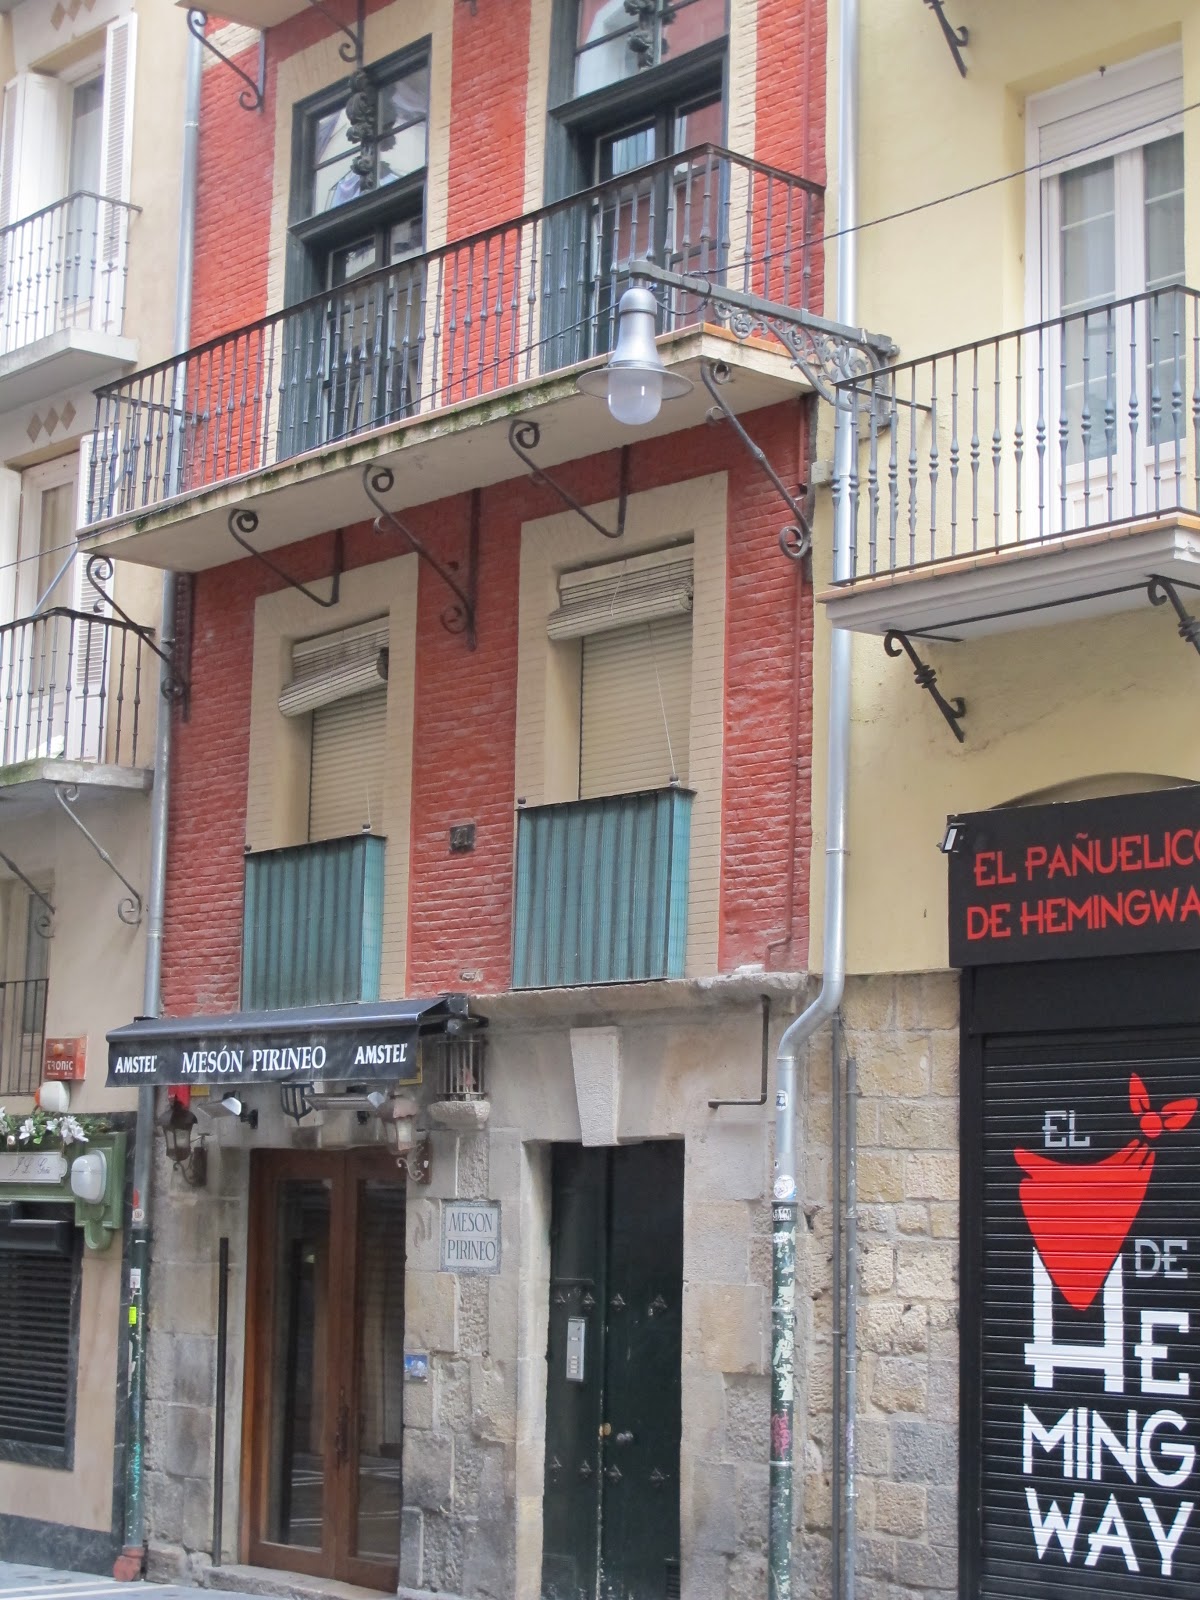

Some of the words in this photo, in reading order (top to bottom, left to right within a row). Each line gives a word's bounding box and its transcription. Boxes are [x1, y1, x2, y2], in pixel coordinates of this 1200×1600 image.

[974, 851, 1016, 887] EL
[967, 903, 1011, 940] DE
[115, 1055, 157, 1074] AMSTEL
[181, 1045, 244, 1073] MESÓN
[251, 1046, 326, 1072] PIRINEO
[354, 1043, 407, 1065] AMSTEL
[1042, 1110, 1090, 1147] EL
[449, 1213, 493, 1232] MESON
[447, 1239, 496, 1261] PIRINEO
[1135, 1240, 1188, 1279] DE
[1024, 1247, 1189, 1395] HE
[1023, 1403, 1196, 1487] MING
[1025, 1487, 1194, 1575] WAY
